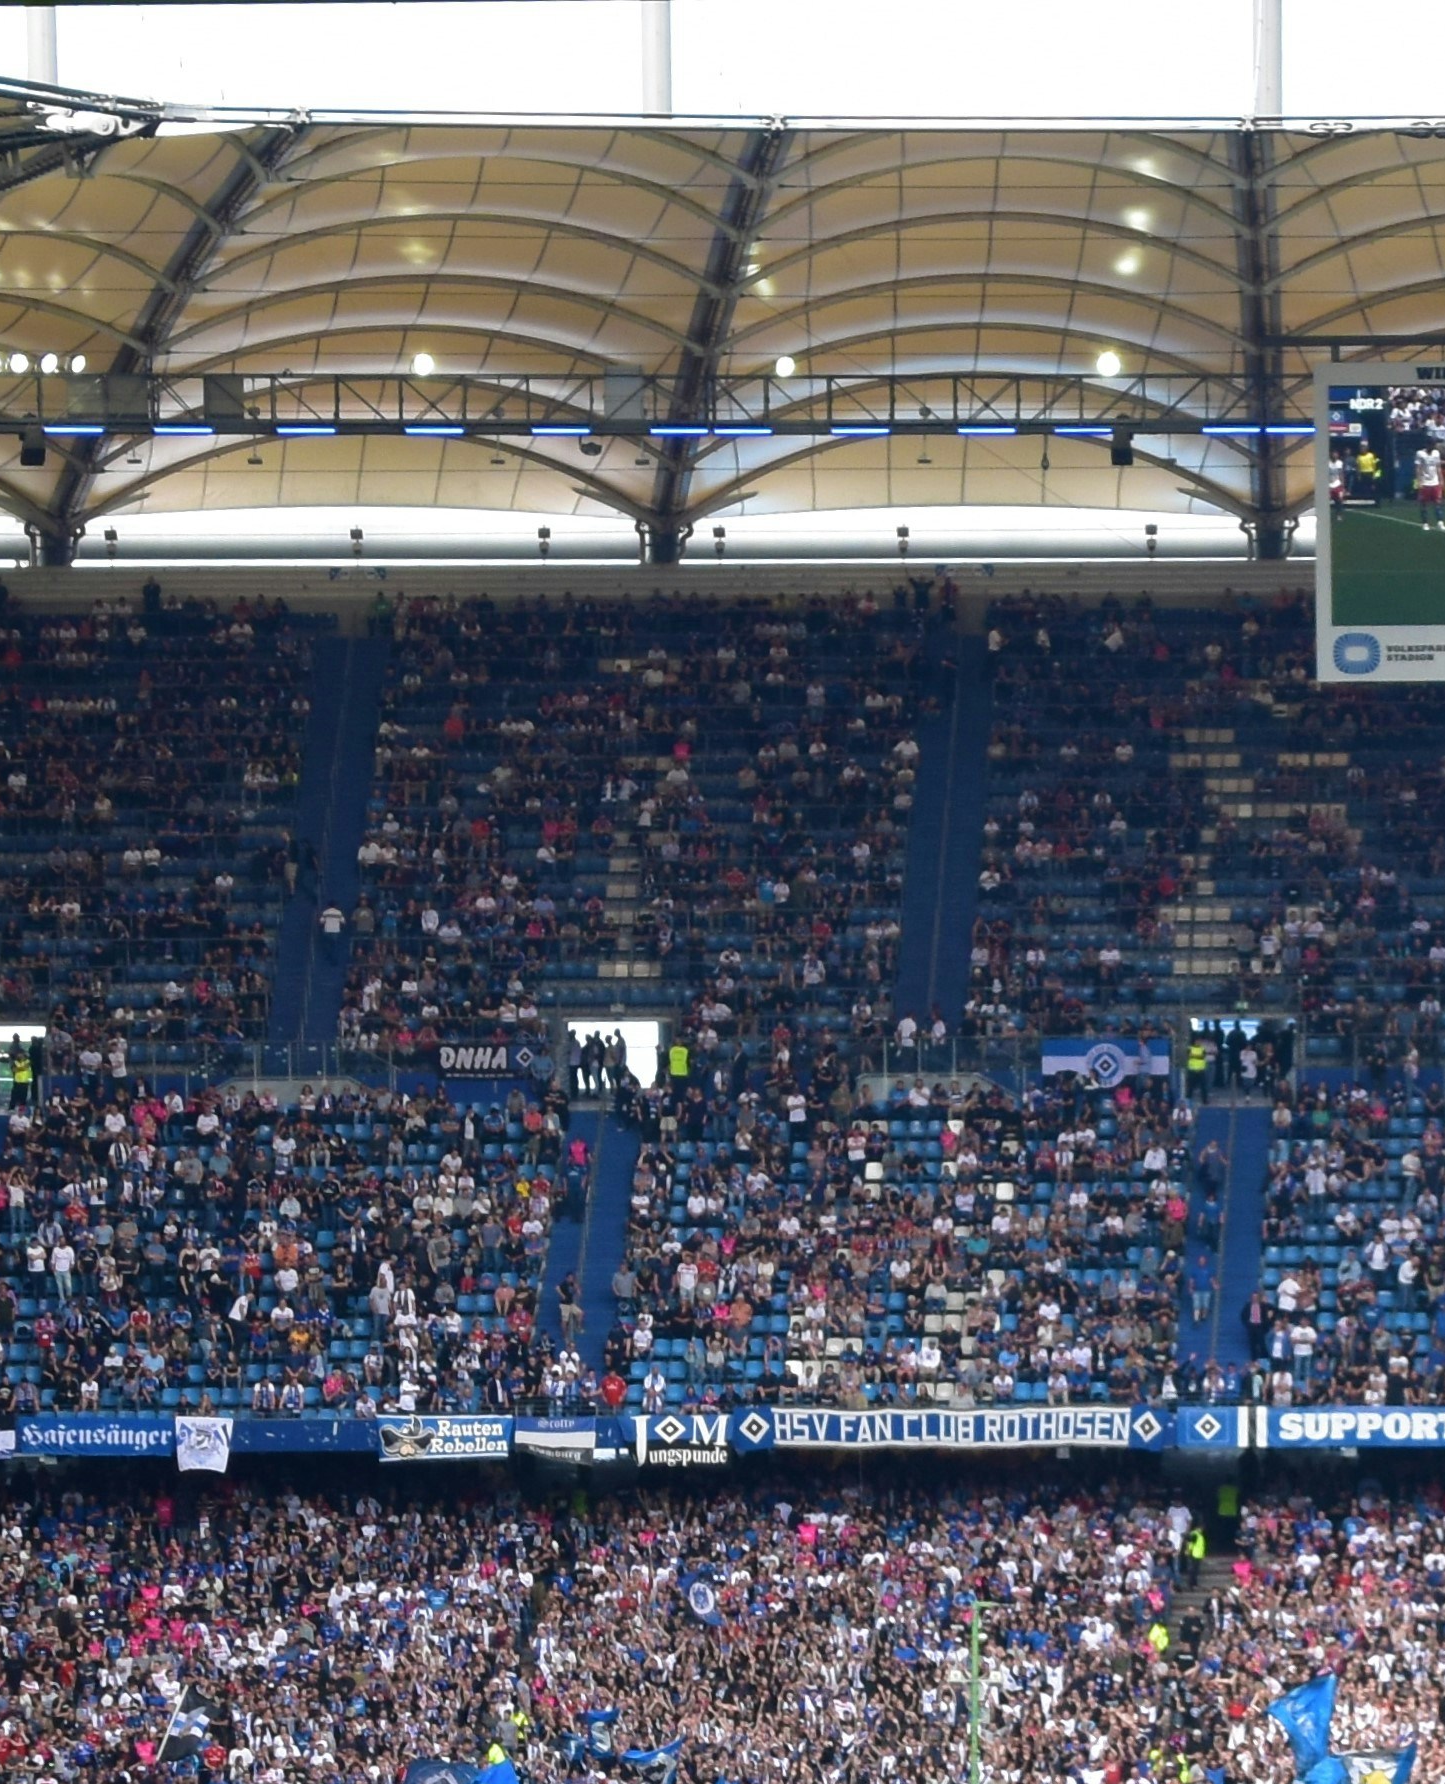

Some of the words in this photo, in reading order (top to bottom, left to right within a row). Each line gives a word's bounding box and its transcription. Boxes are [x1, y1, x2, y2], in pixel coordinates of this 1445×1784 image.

[437, 1418, 504, 1435] Rauten
[774, 1410, 828, 1441] HSV
[840, 1411, 893, 1441] FAN
[904, 1411, 975, 1441] CLUB
[430, 1436, 508, 1453] Rebellen
